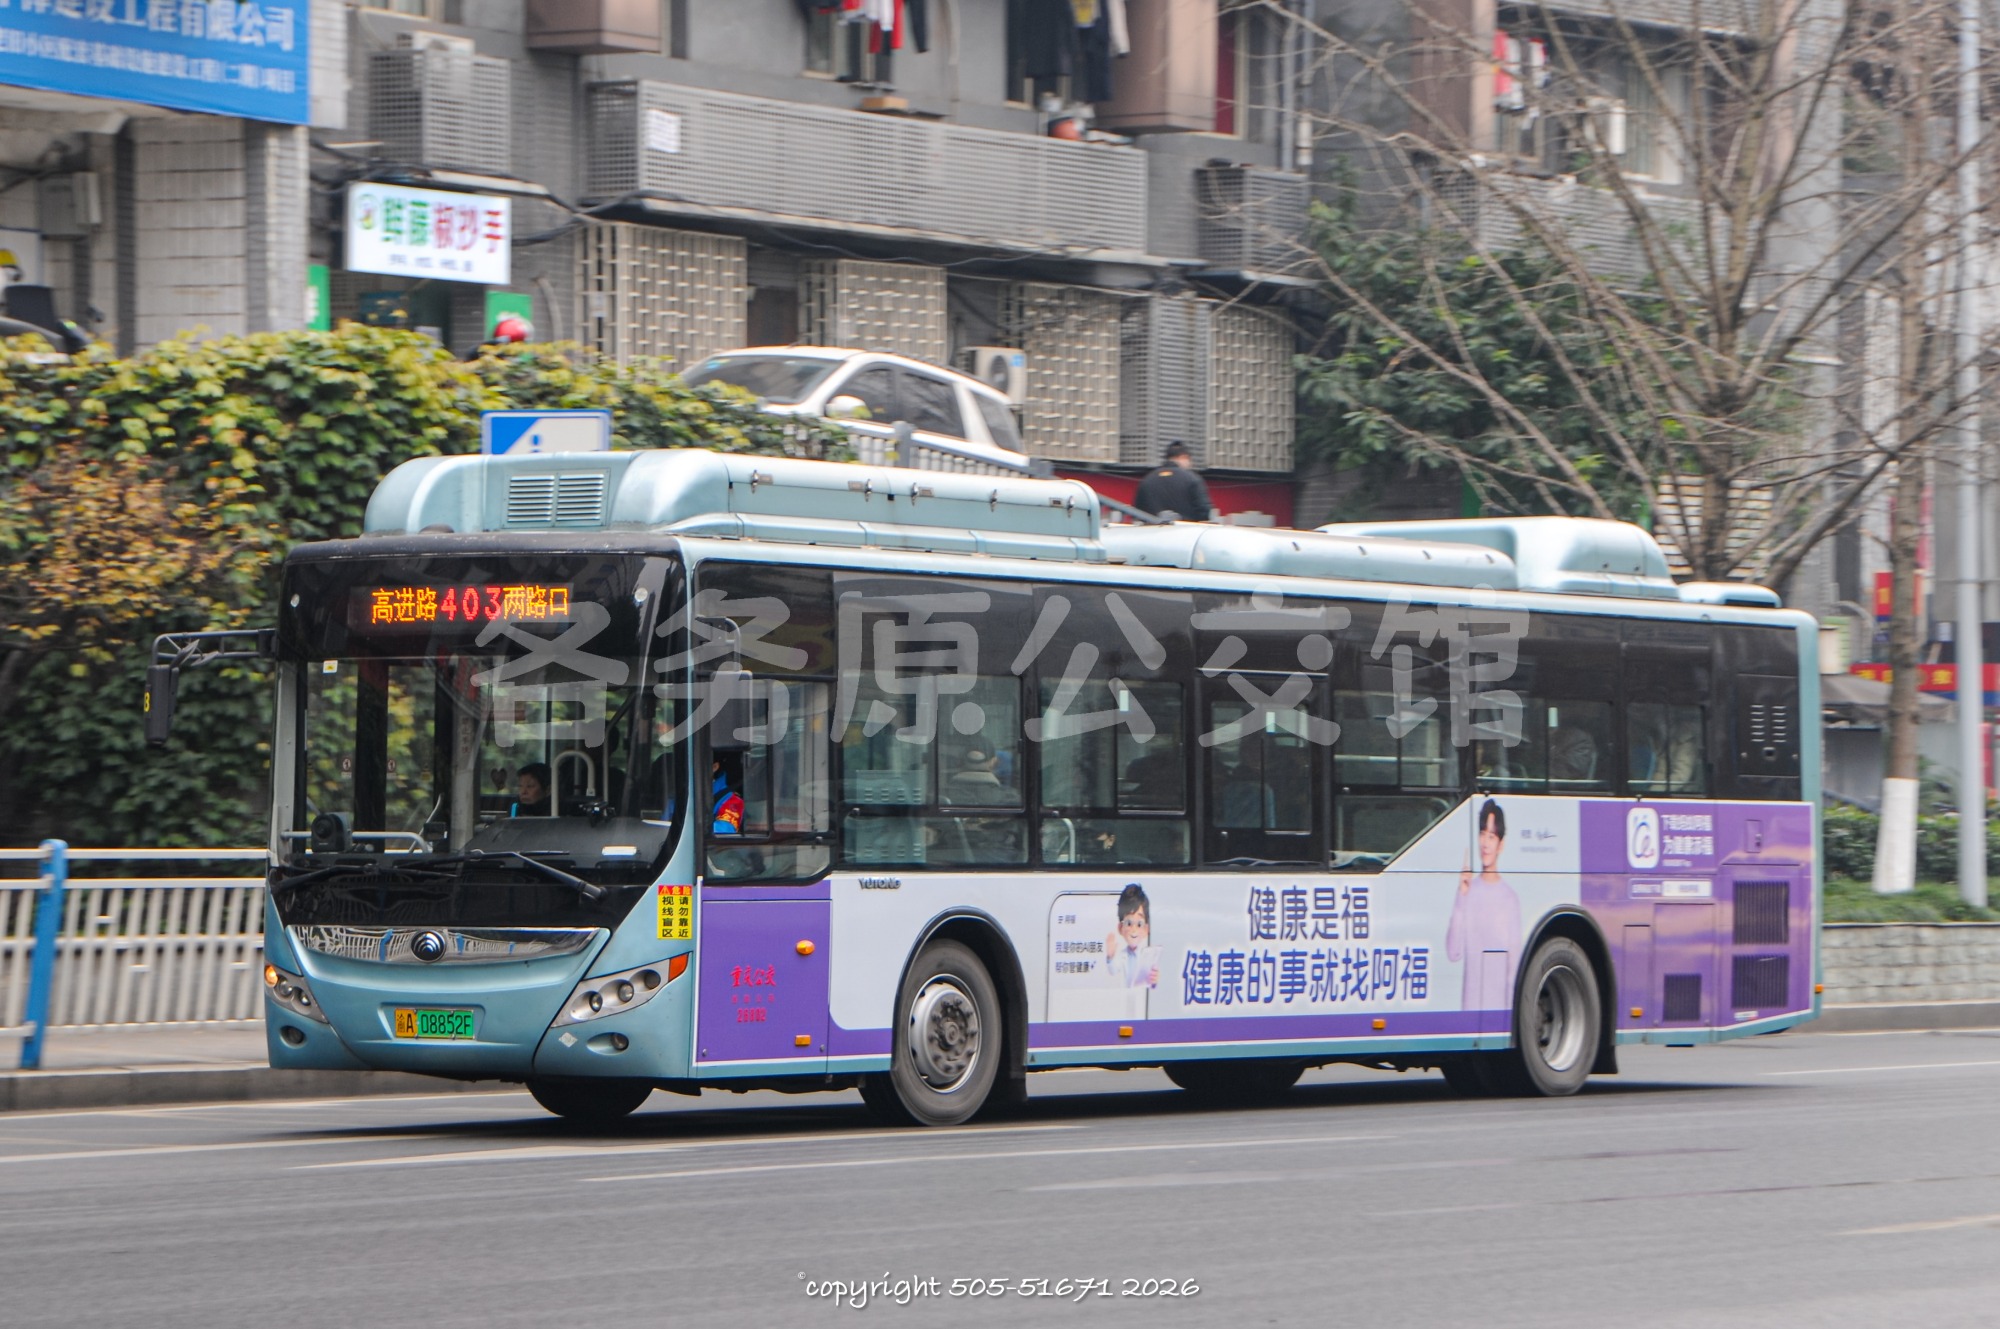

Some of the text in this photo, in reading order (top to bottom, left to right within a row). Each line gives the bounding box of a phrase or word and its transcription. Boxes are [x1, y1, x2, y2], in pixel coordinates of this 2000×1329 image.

[662, 895, 674, 938] 视线盲区
[1248, 885, 1369, 941] 健康是福
[1182, 947, 1429, 1005] 健康的事就找阿福
